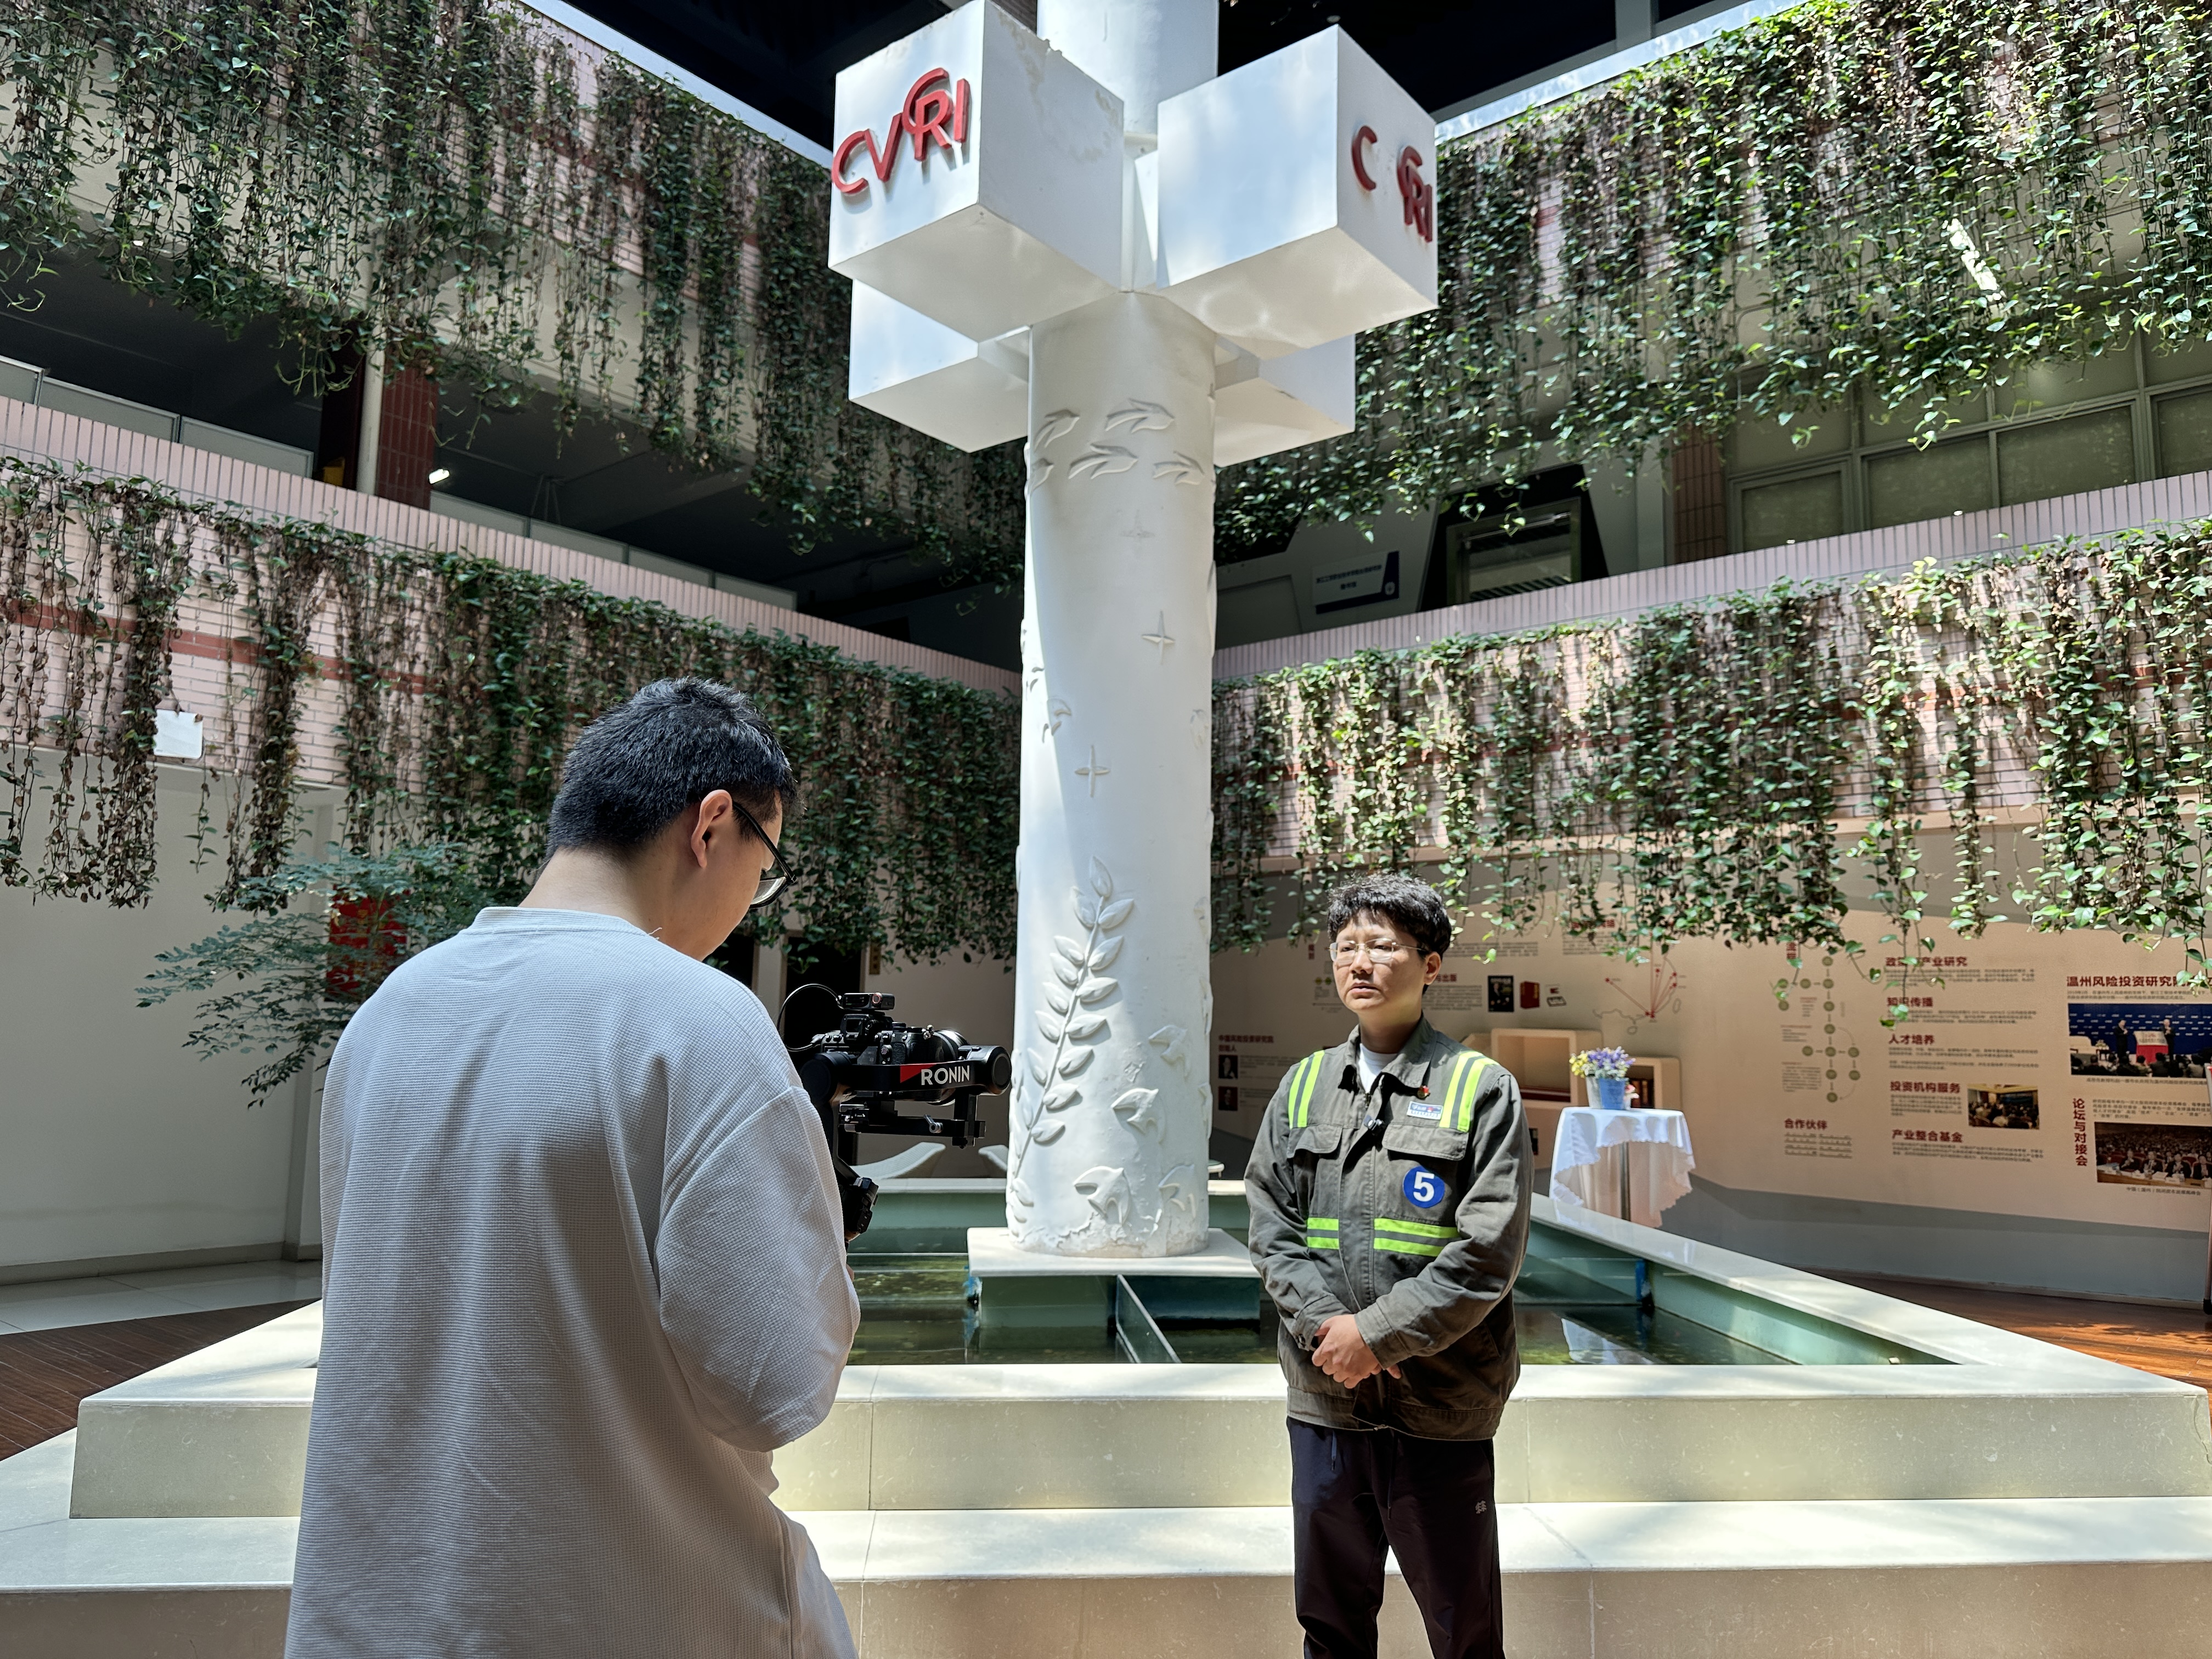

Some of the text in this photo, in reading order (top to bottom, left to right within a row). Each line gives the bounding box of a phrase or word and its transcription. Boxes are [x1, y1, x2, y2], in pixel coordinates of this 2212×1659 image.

[1886, 956, 1968, 967] 政策产业研究
[1888, 1034, 1935, 1045] 人才培养
[921, 1065, 970, 1086] RONIN
[1891, 1081, 1960, 1093] 投资机构服务
[1784, 1118, 1827, 1130] 合作伙伴
[1892, 1128, 1963, 1143] 产业整合基金
[2073, 1098, 2087, 1166] 论坛与对接会
[1413, 1171, 1435, 1202] 5
